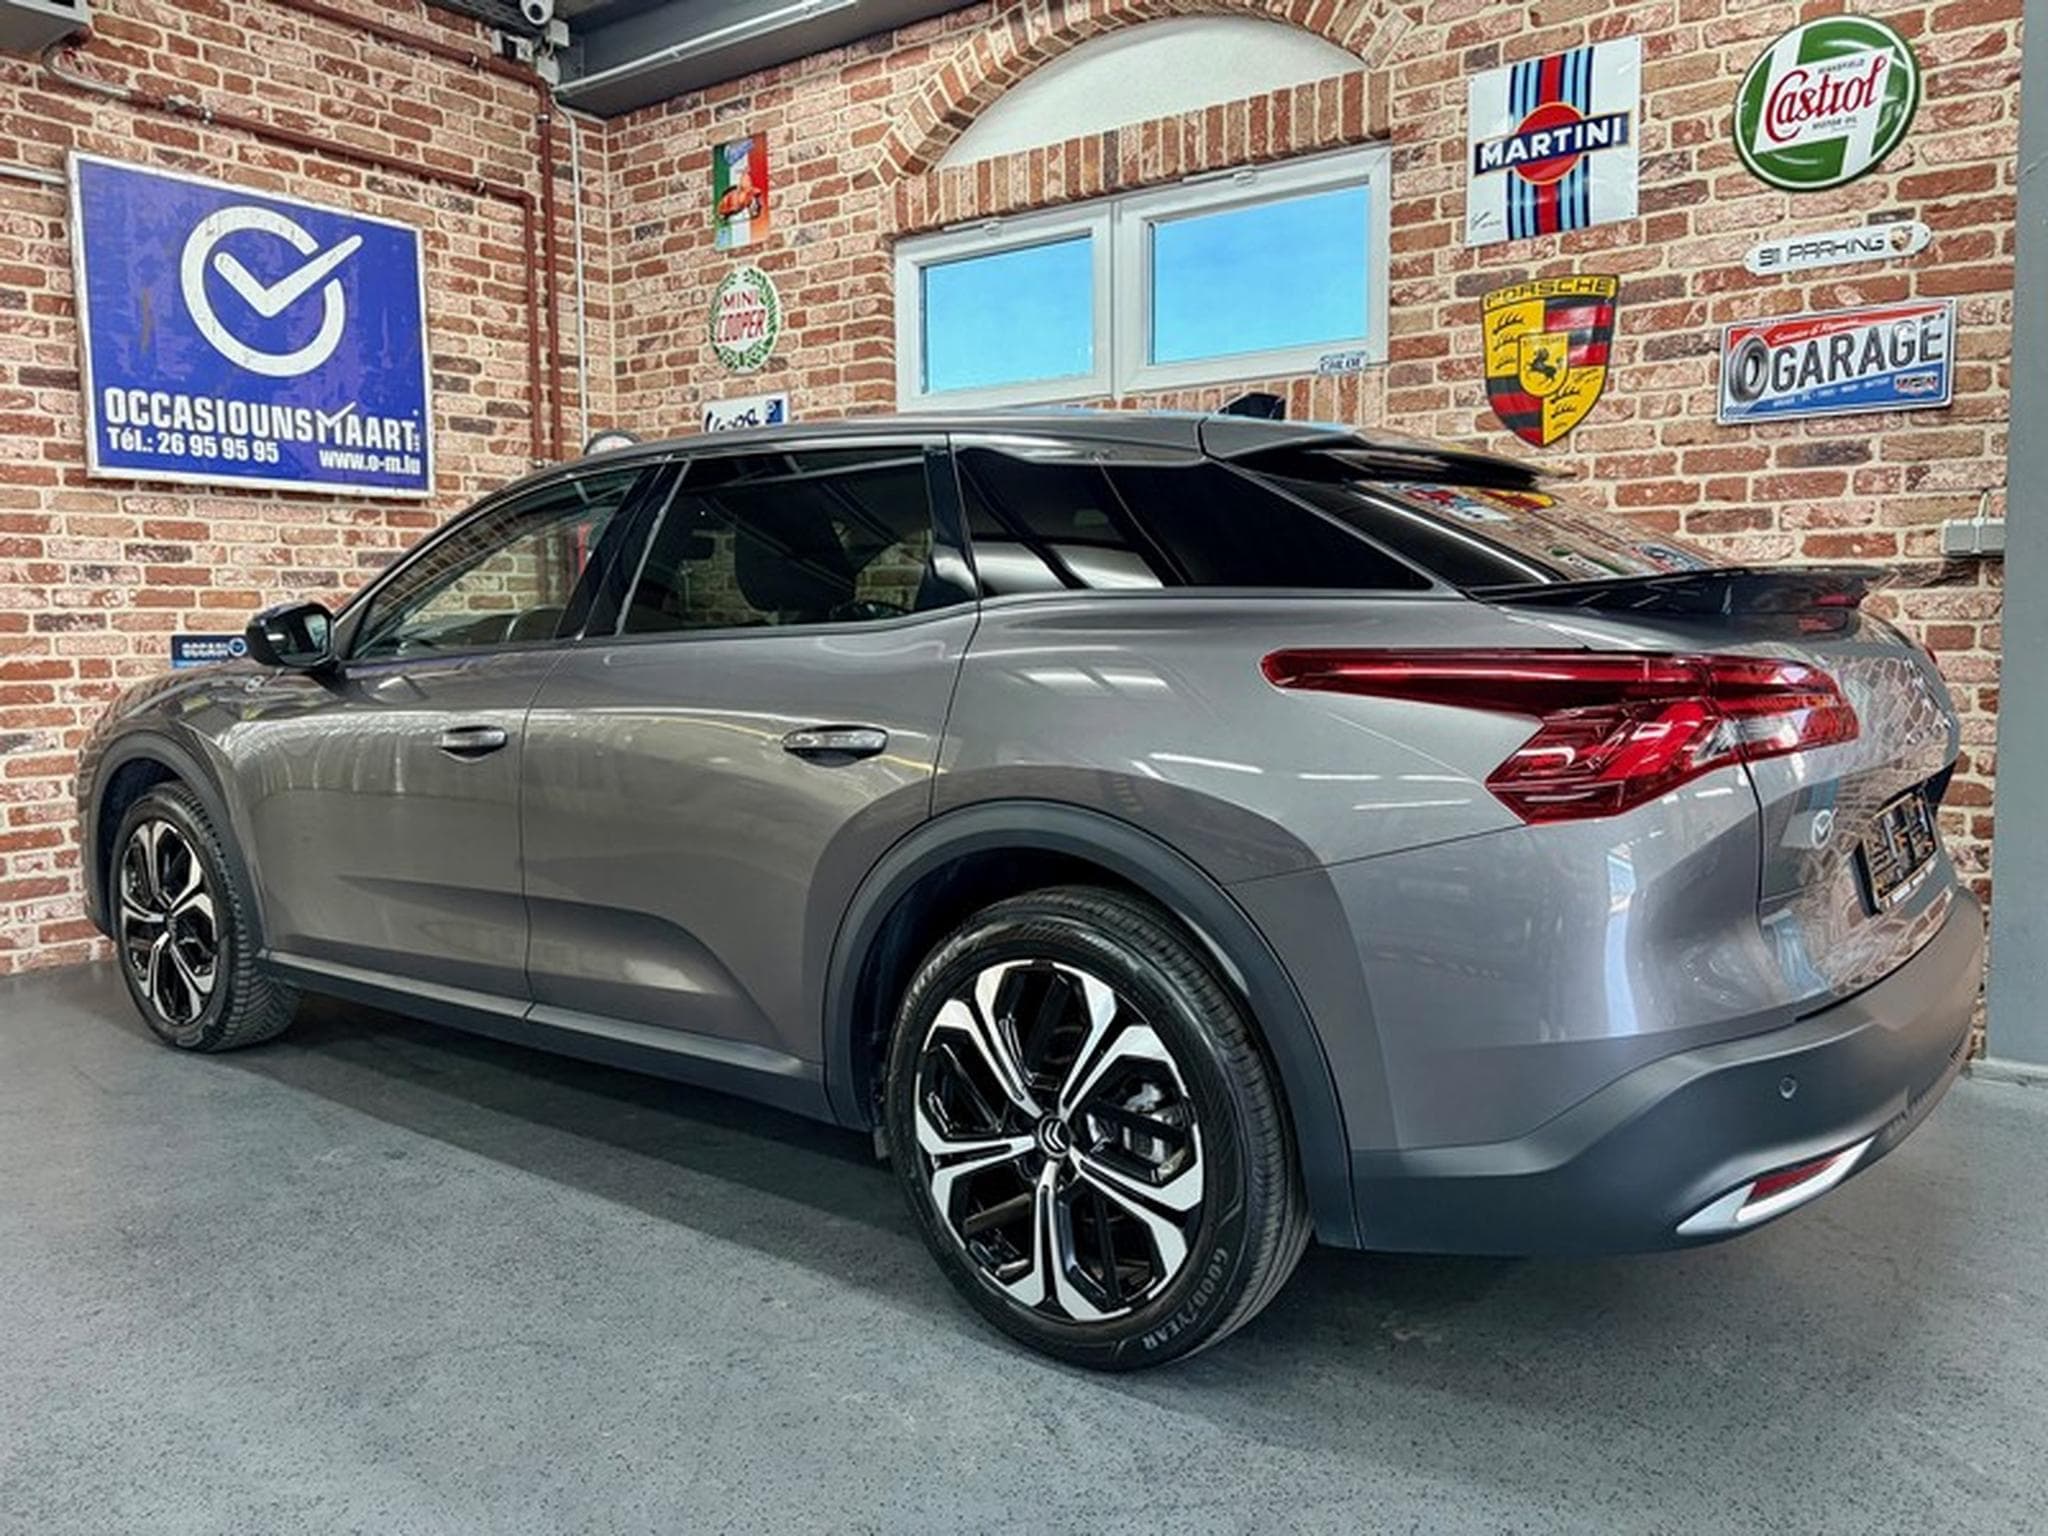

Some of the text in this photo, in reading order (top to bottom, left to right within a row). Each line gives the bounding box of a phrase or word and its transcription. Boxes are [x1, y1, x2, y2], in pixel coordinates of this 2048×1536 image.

[1765, 54, 1887, 143] Castrol
[1480, 116, 1621, 169] MARTINI
[1786, 233, 1885, 262] PARKING
[723, 289, 758, 310] MINI
[1486, 279, 1611, 308] PORSCHE
[717, 309, 765, 343] COOPER
[1771, 312, 1945, 394] GARAGE
[106, 427, 280, 464] Tél.: 26 95 95 95
[318, 449, 421, 476] www.o-m.lu
